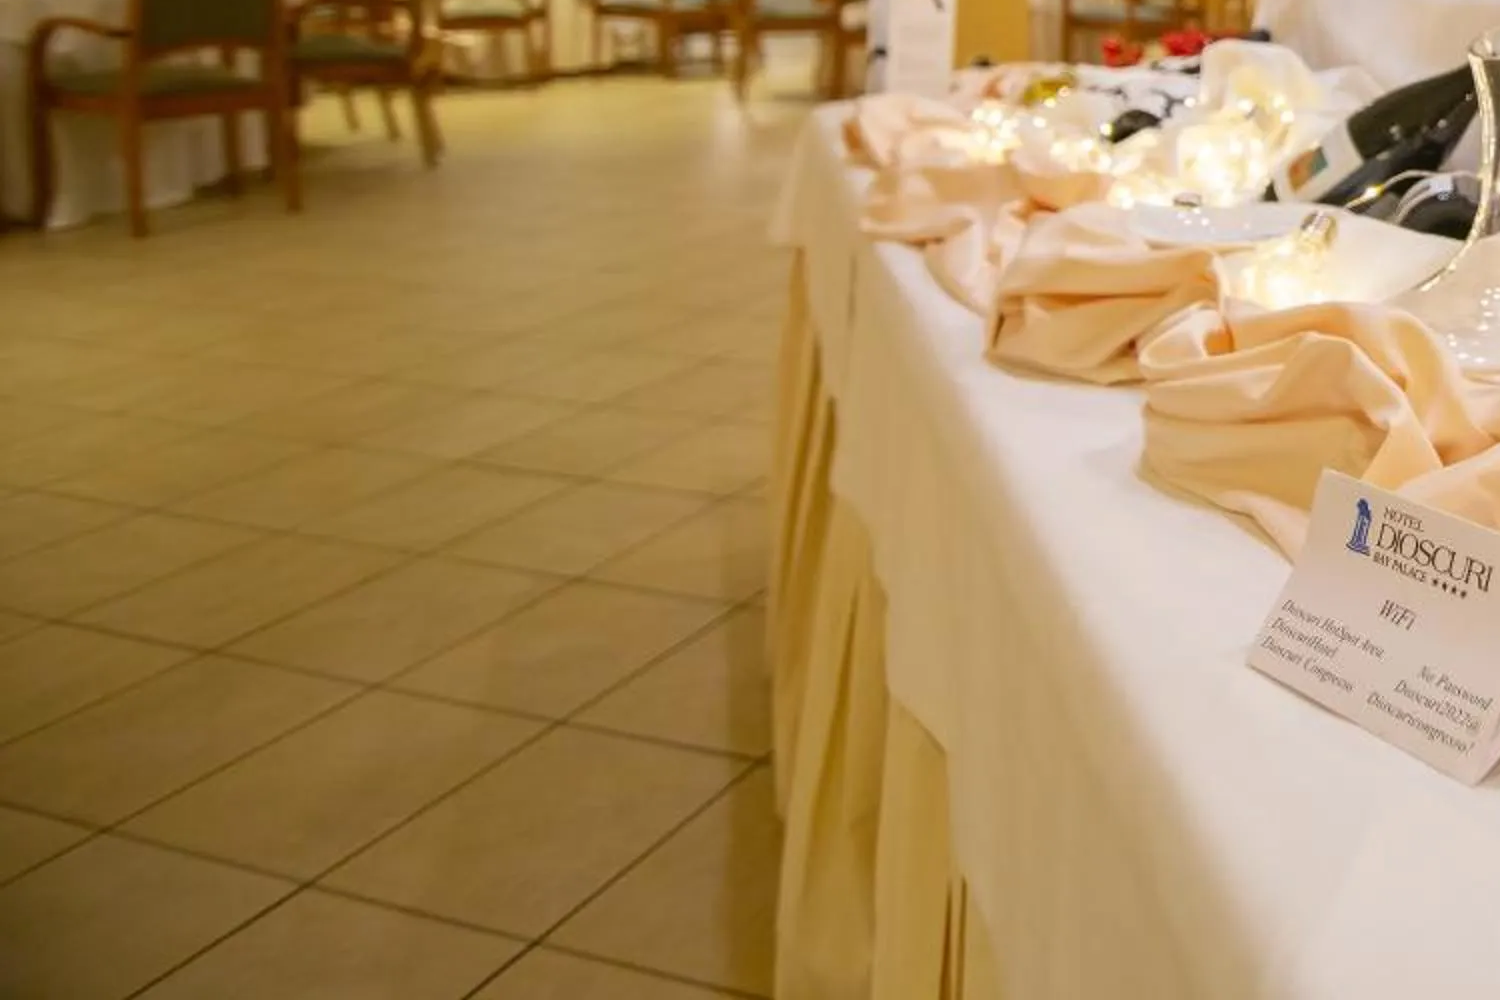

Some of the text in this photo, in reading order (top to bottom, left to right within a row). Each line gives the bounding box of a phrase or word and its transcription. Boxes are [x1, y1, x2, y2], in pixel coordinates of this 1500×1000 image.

[1384, 506, 1424, 533] HOTEL
[1376, 523, 1493, 593] DIOSCURI
[1392, 559, 1427, 583] PALACE
[1435, 674, 1494, 712] Password
